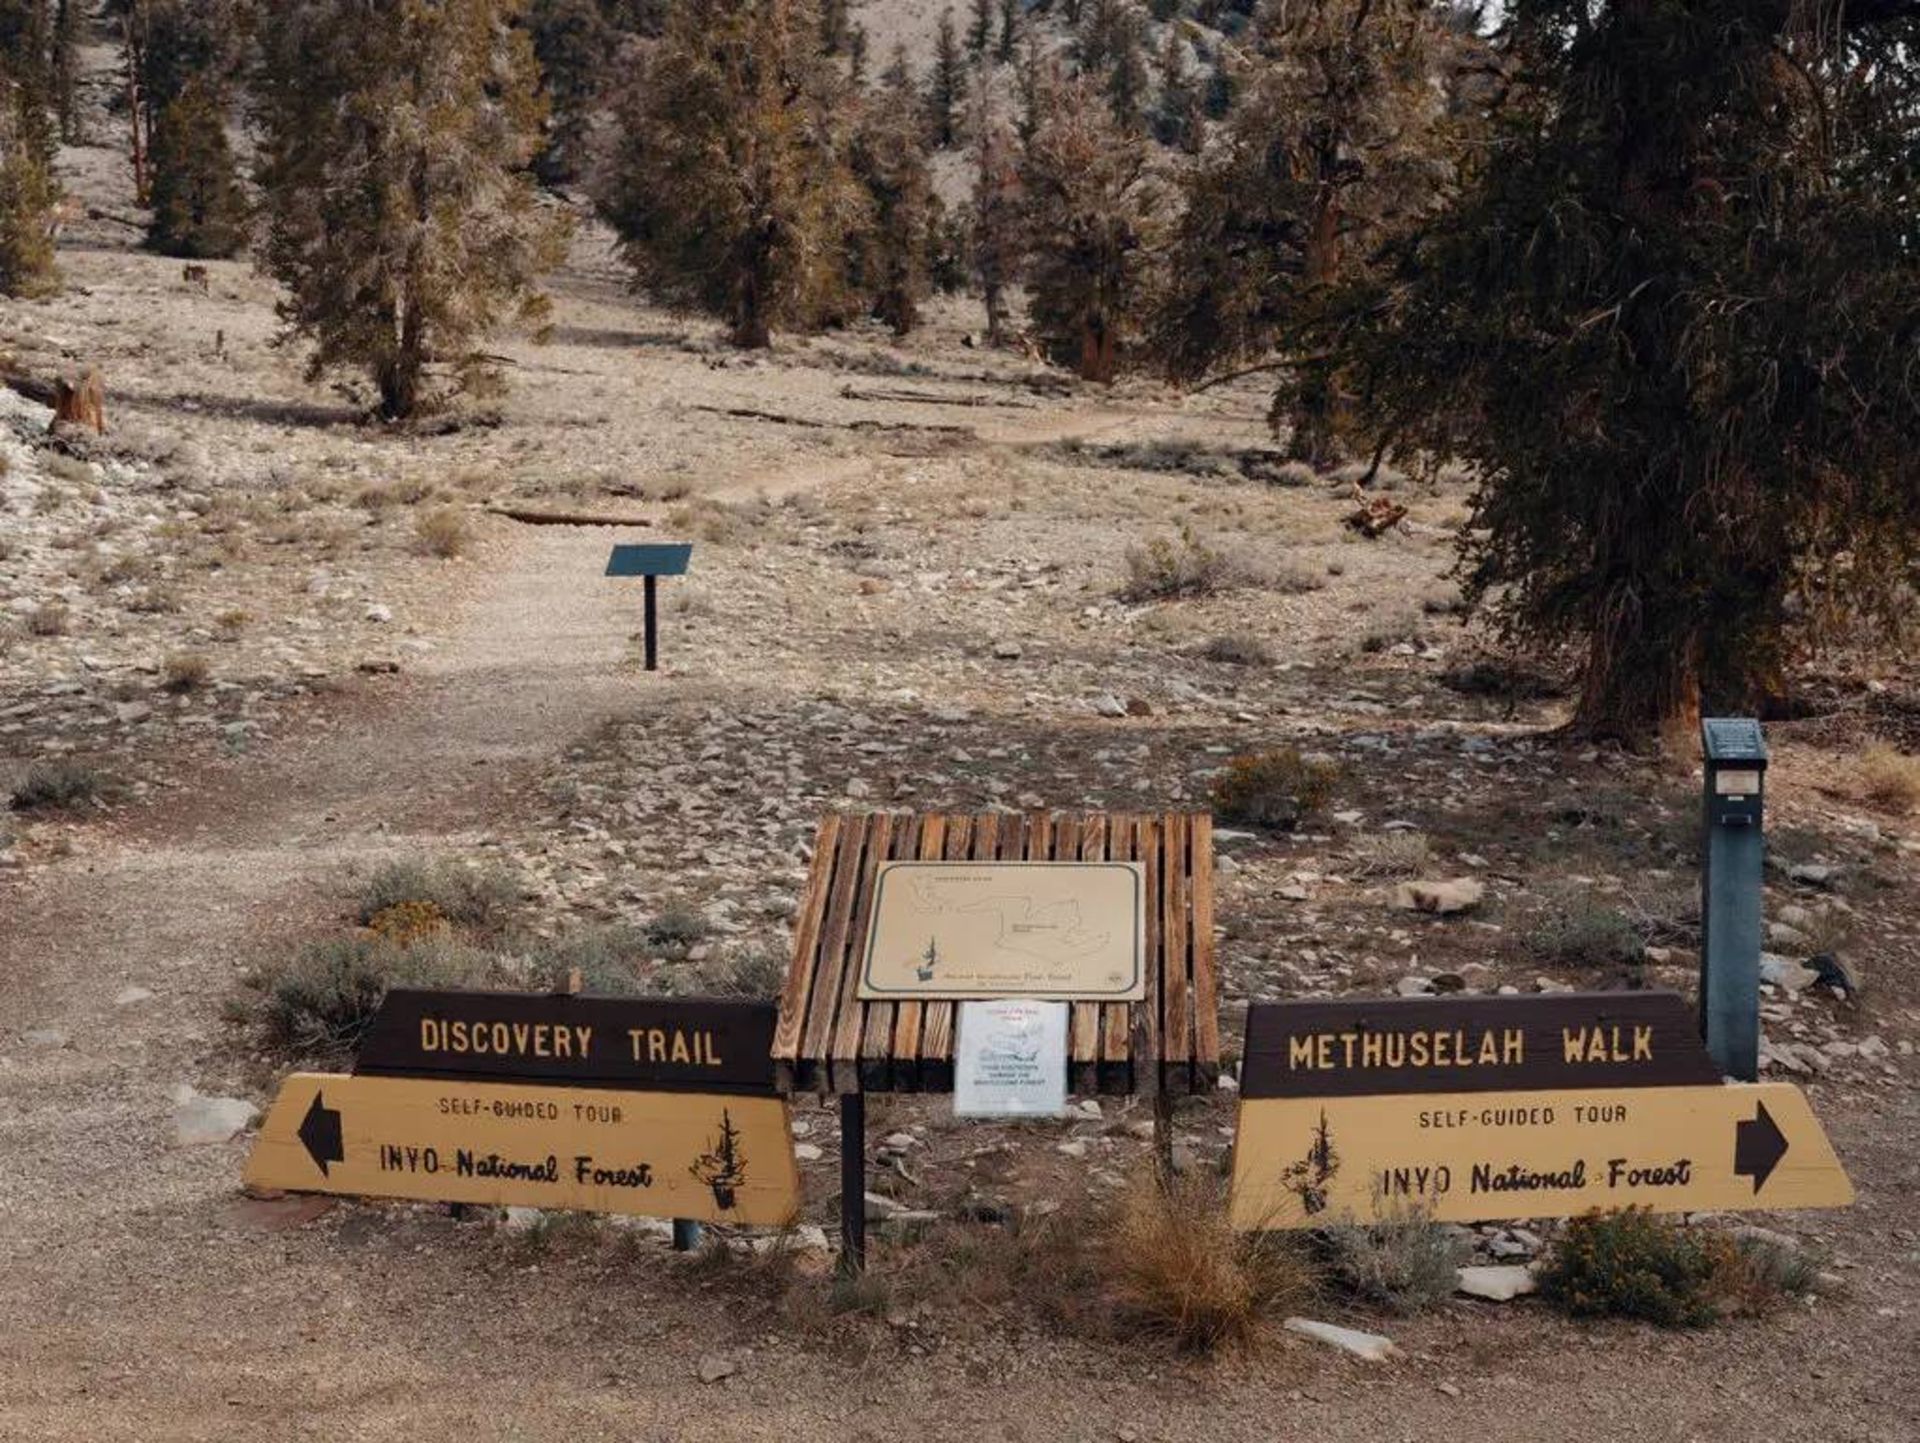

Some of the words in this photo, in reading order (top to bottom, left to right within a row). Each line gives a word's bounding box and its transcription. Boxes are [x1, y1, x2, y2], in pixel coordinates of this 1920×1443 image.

[420, 1018, 593, 1058] DISCOVERY
[627, 1028, 723, 1065] TRAIL
[1289, 1029, 1524, 1071] METHUSELAH
[1562, 1025, 1653, 1064] WALK
[439, 1098, 558, 1121] SELF-GUIDED
[573, 1104, 624, 1123] TOUR
[1419, 1107, 1555, 1128] SELF-GUIDED
[1574, 1105, 1628, 1123] TOUR
[379, 1145, 439, 1174] INYO
[456, 1148, 559, 1184] National
[575, 1156, 653, 1188] Forest
[1383, 1166, 1450, 1196] INYO
[1470, 1159, 1586, 1194] National
[1607, 1158, 1692, 1188] Forest
